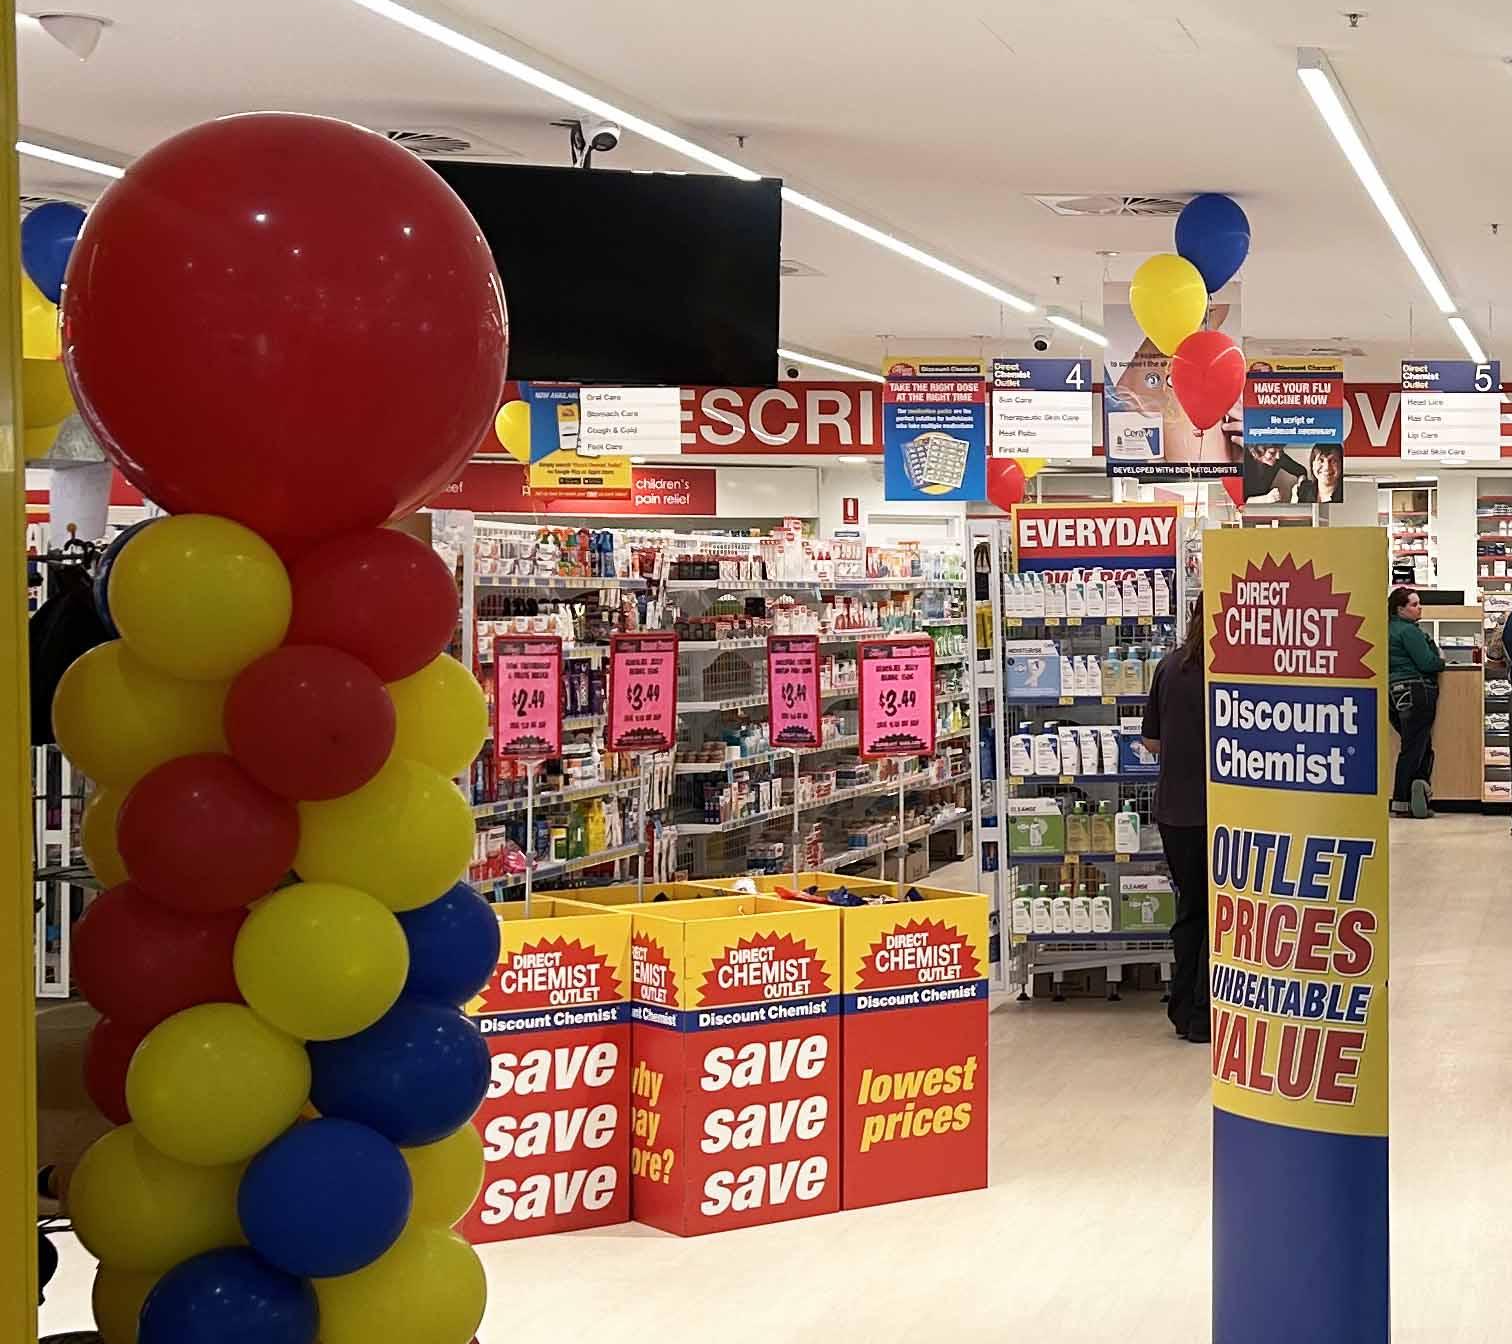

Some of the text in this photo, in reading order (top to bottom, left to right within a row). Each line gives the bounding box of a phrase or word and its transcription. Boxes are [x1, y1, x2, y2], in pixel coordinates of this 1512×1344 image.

[994, 363, 1019, 371] Direct
[994, 370, 1031, 379] Chemist
[1065, 362, 1084, 391] 4
[1402, 364, 1428, 372] Direct
[1402, 372, 1440, 380] Chemist
[1474, 364, 1493, 392] 5
[890, 383, 979, 392] TAKE THE RIGHT DOSE
[994, 379, 1020, 387] Outlet
[1254, 382, 1332, 393] HAVE YOUR FLU
[1402, 380, 1429, 389] Outlet
[896, 393, 973, 401] AT THE RIGHT TIME
[999, 396, 1032, 404] Sun Care
[1257, 394, 1328, 405] VACCINE NOW
[999, 414, 1042, 422] Therapeutic
[1282, 415, 1305, 425] script
[999, 446, 1029, 454] First Aid
[1113, 466, 1238, 474] DEVELOPED WITH DERMATOLOGISTS
[636, 478, 690, 490] children's
[635, 493, 690, 506] pain relief
[1019, 516, 1175, 548] EVERYDAY
[1237, 582, 1290, 606] DIRECT
[1225, 607, 1339, 647] CHEMIST
[1274, 649, 1338, 674] OUTLET
[512, 688, 545, 717] $2.49
[627, 683, 660, 711] $3.49
[879, 689, 916, 717] $3.49
[1215, 689, 1358, 735] Discount
[1215, 737, 1345, 785] Chemist
[1211, 824, 1376, 903] OUTLET
[886, 932, 928, 949] DIRECT
[1213, 891, 1377, 977] PRICES
[513, 951, 562, 970] DIRECT
[729, 946, 775, 965] DIRECT
[875, 943, 961, 973] CHEMIST
[500, 963, 600, 994] CHEMIST
[633, 960, 667, 989] EMIST
[717, 957, 811, 989] CHEMIST
[918, 965, 962, 983] OUTLET
[550, 987, 600, 1005] OUTLET
[640, 985, 668, 1003] OUTLET
[763, 980, 811, 999] OUTLET
[857, 984, 976, 1009] Discount Chemist
[1212, 963, 1372, 1024] UNBEATABLE
[480, 1014, 551, 1033] Discount
[553, 1007, 617, 1026] Chemist
[642, 1008, 677, 1027] Chemist
[699, 1000, 827, 1027] Discount Chemist
[700, 1033, 828, 1093] save
[1212, 1007, 1367, 1106] VALUE
[486, 1042, 618, 1099] save
[857, 1056, 977, 1106] lowest
[483, 1104, 618, 1162] save
[632, 1106, 661, 1147] ay
[700, 1094, 828, 1155] save
[860, 1100, 972, 1153] prices
[631, 1147, 675, 1185] ore?
[480, 1165, 617, 1225] save
[700, 1155, 828, 1217] save
